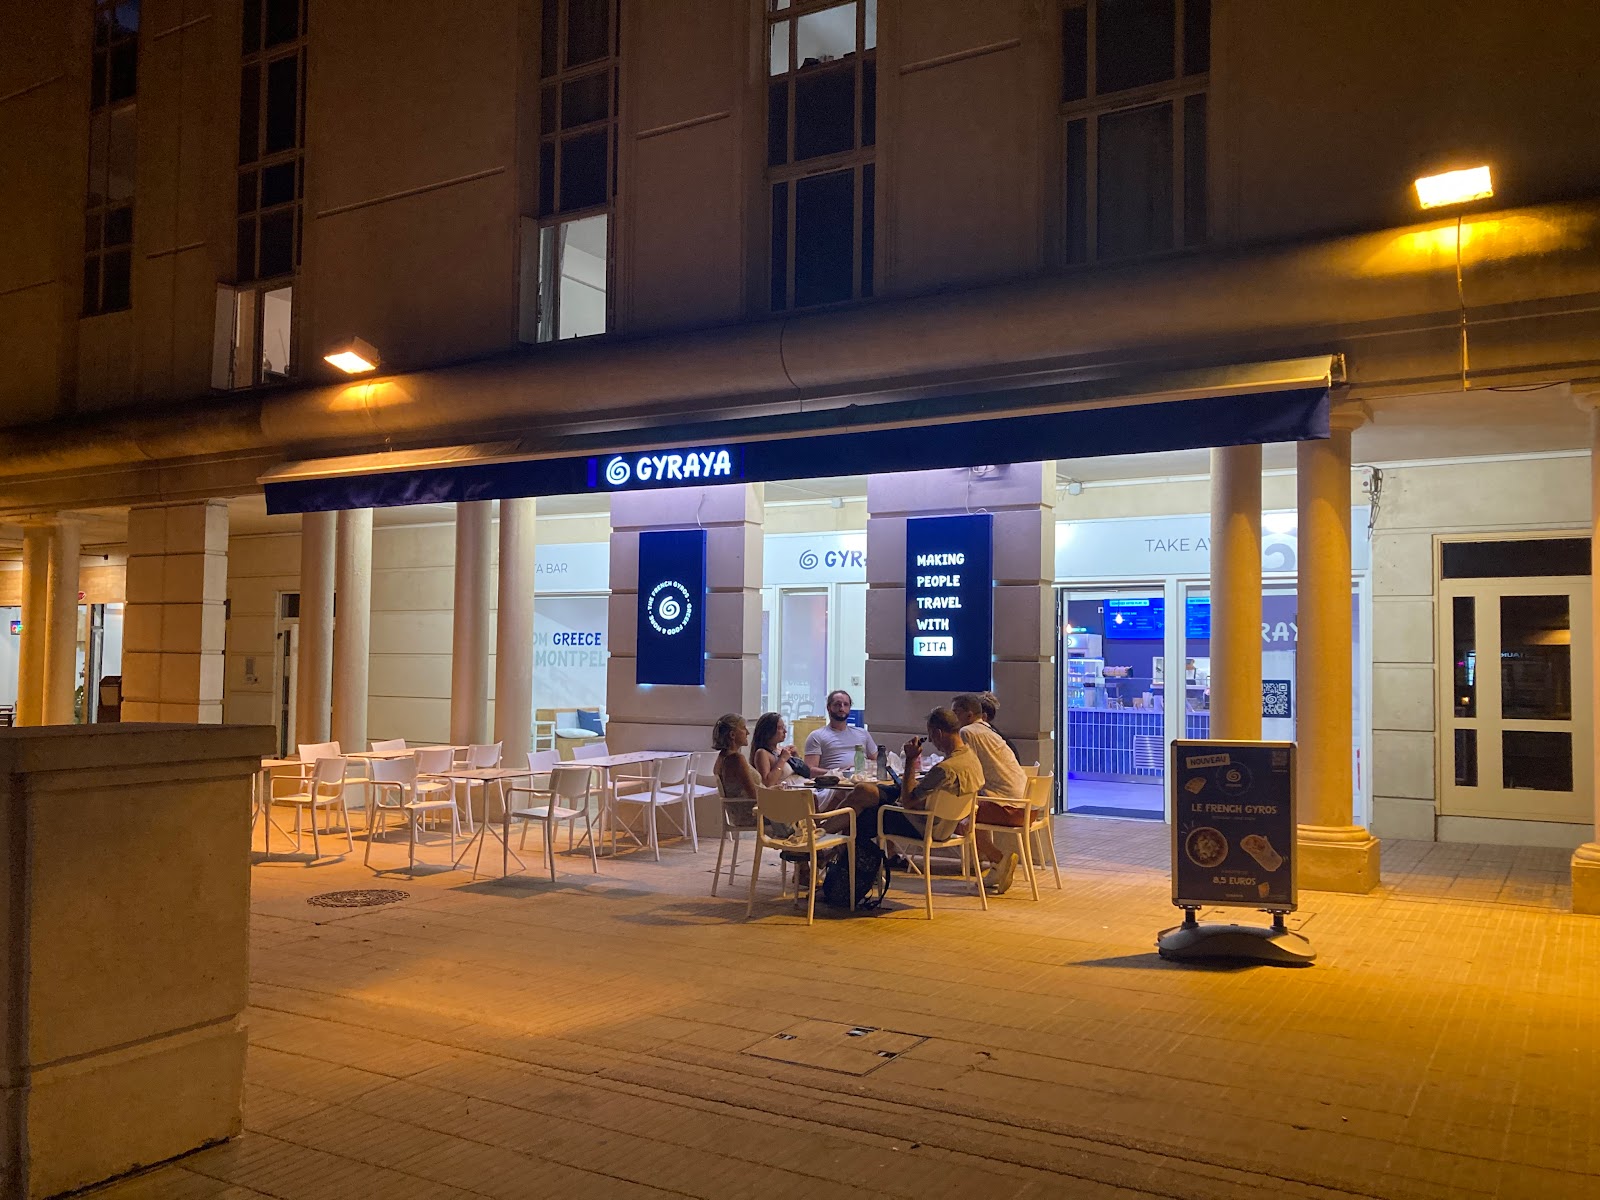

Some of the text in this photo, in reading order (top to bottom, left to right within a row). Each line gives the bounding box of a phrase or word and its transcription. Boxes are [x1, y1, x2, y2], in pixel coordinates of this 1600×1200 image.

[636, 450, 731, 481] GYRAYA
[1145, 538, 1210, 552] TAKE A
[825, 549, 867, 568] GYR
[917, 553, 965, 567] MAKING
[546, 563, 568, 574] BAR
[916, 575, 960, 588] PEOPLE
[651, 580, 673, 597] FRENCH
[673, 581, 690, 599] GYROS
[916, 597, 962, 609] TRAVEL
[666, 624, 684, 636] FOOD
[916, 618, 950, 631] WITH
[553, 633, 602, 647] GREECE
[919, 642, 947, 652] PITA
[1190, 755, 1227, 766] NOUVEAU
[1191, 803, 1278, 815] LE FRENCH GYROS
[1229, 877, 1257, 886] EUROS
